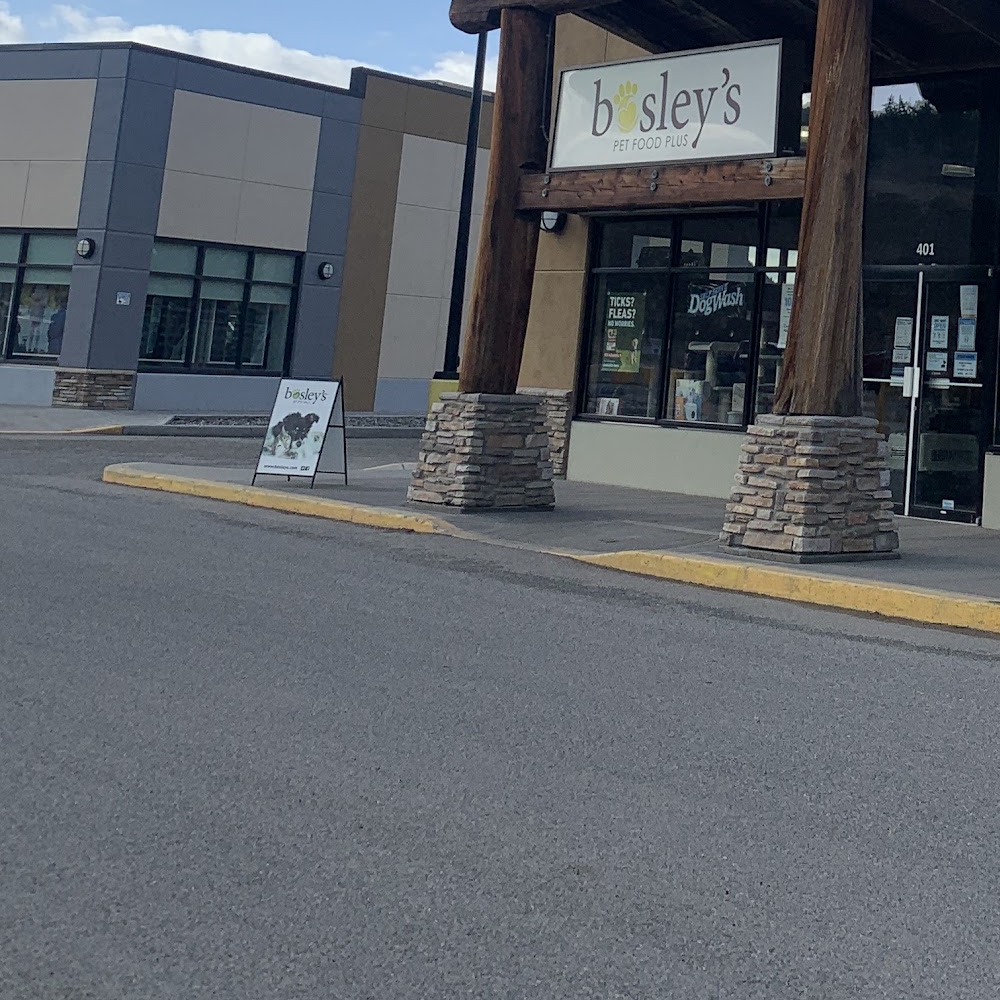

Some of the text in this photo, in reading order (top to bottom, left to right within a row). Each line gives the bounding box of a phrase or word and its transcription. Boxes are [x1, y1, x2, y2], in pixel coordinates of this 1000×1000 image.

[613, 134, 689, 152] PET FOOD PLUS
[916, 243, 935, 256] 401
[609, 296, 635, 308] TICKS?
[608, 308, 637, 319] FLEAS?
[284, 386, 327, 404] bosley's
